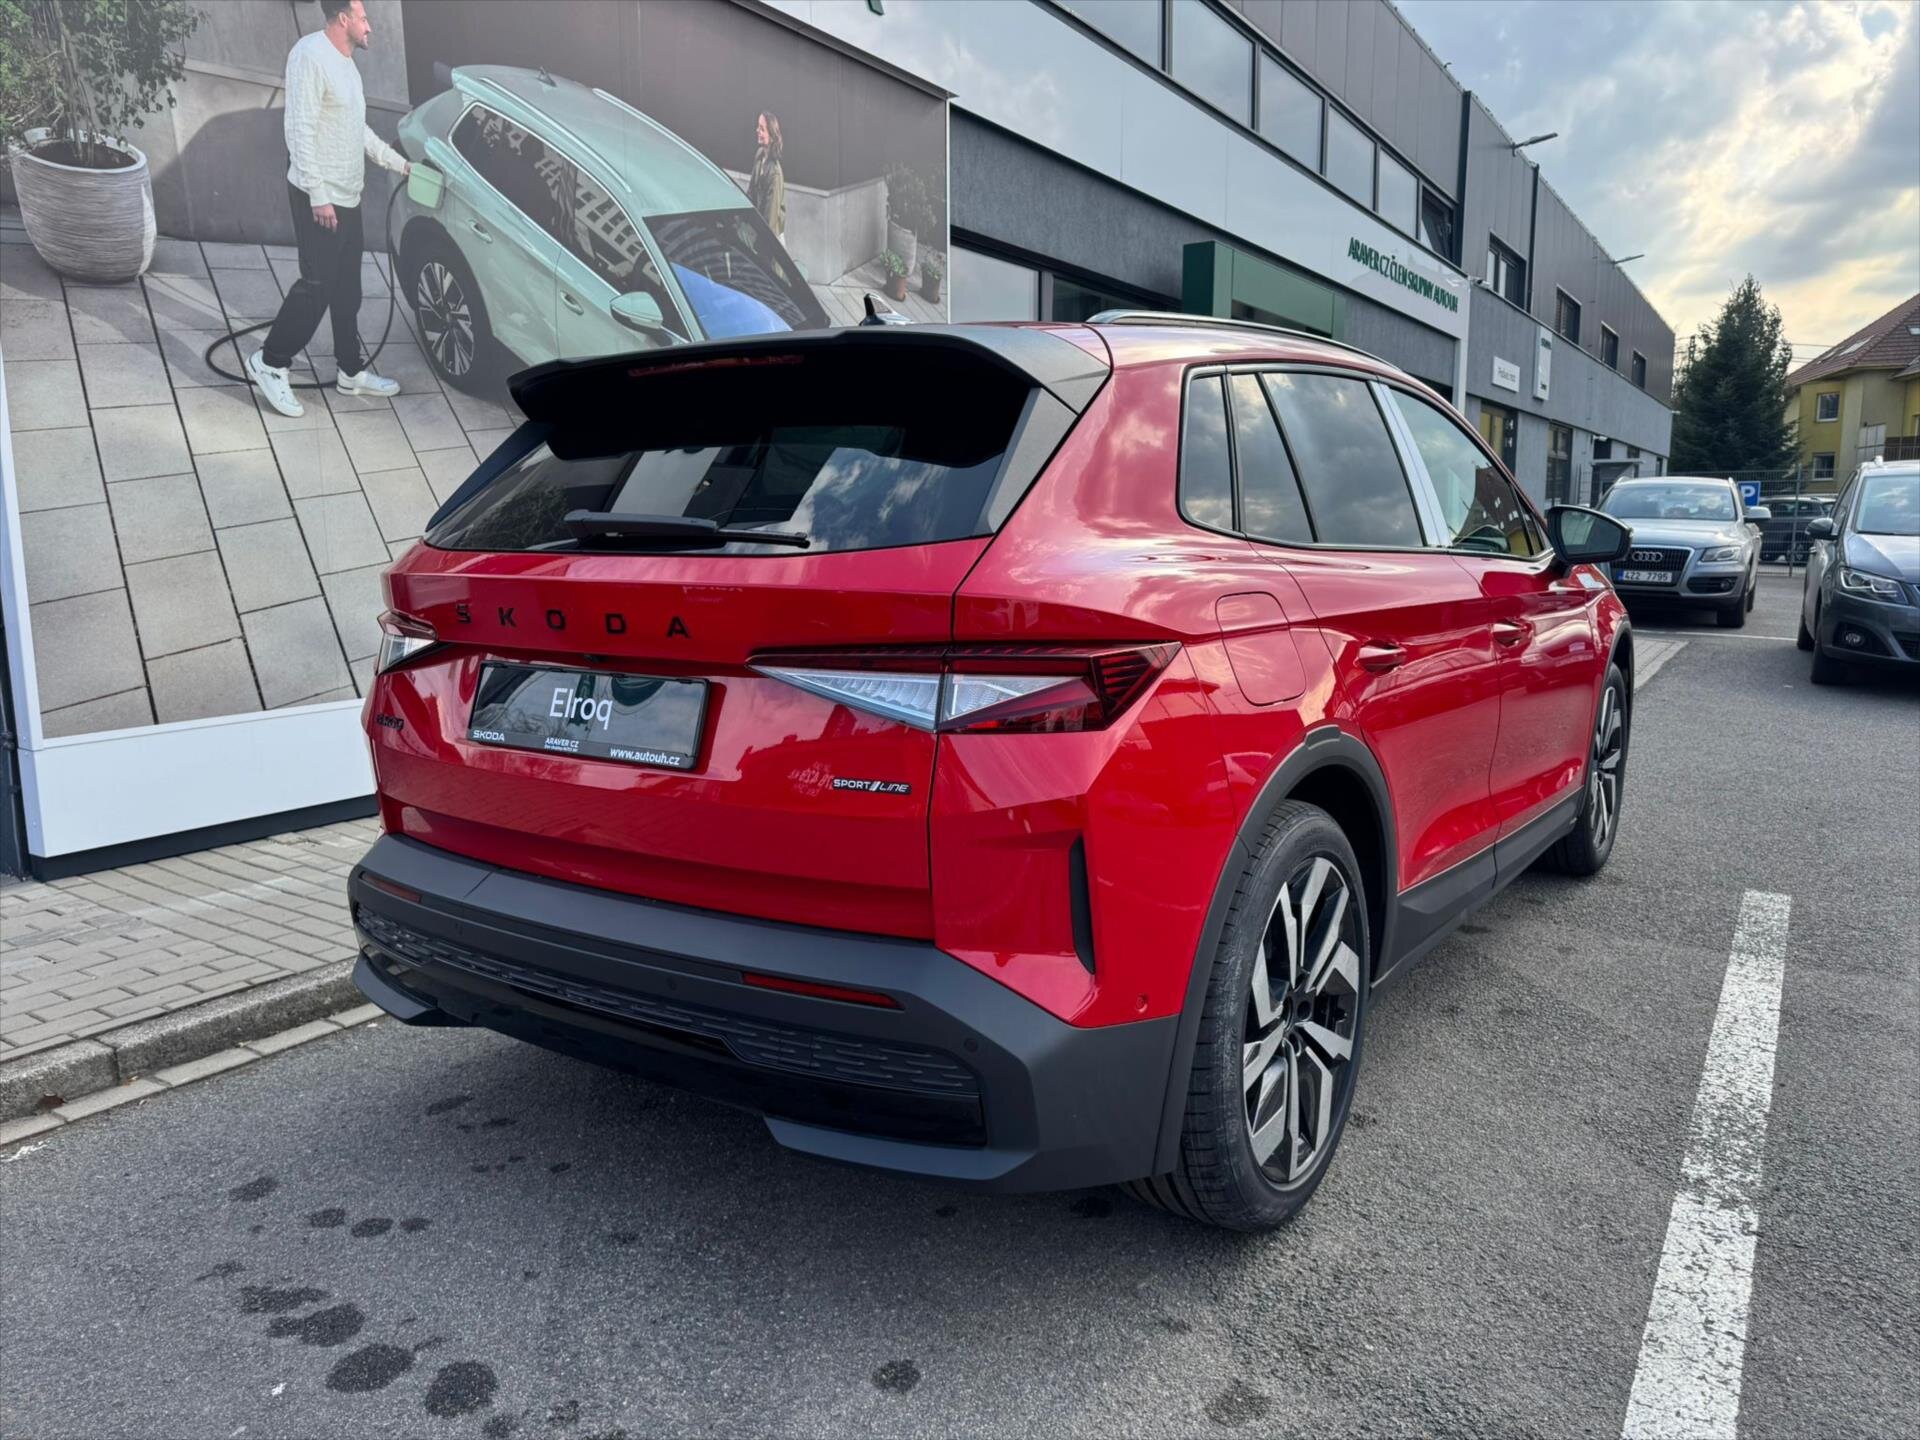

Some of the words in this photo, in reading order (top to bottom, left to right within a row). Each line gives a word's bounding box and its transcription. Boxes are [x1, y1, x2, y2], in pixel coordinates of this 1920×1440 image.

[1348, 237, 1380, 272] ARAVER
[1380, 254, 1390, 278] CZ
[1741, 485, 1755, 498] P
[1647, 572, 1668, 581] 7795
[549, 687, 614, 731] Elroq
[545, 737, 570, 747] ARAVER
[570, 740, 579, 748] CZ
[610, 748, 680, 766] www.autouh.cz
